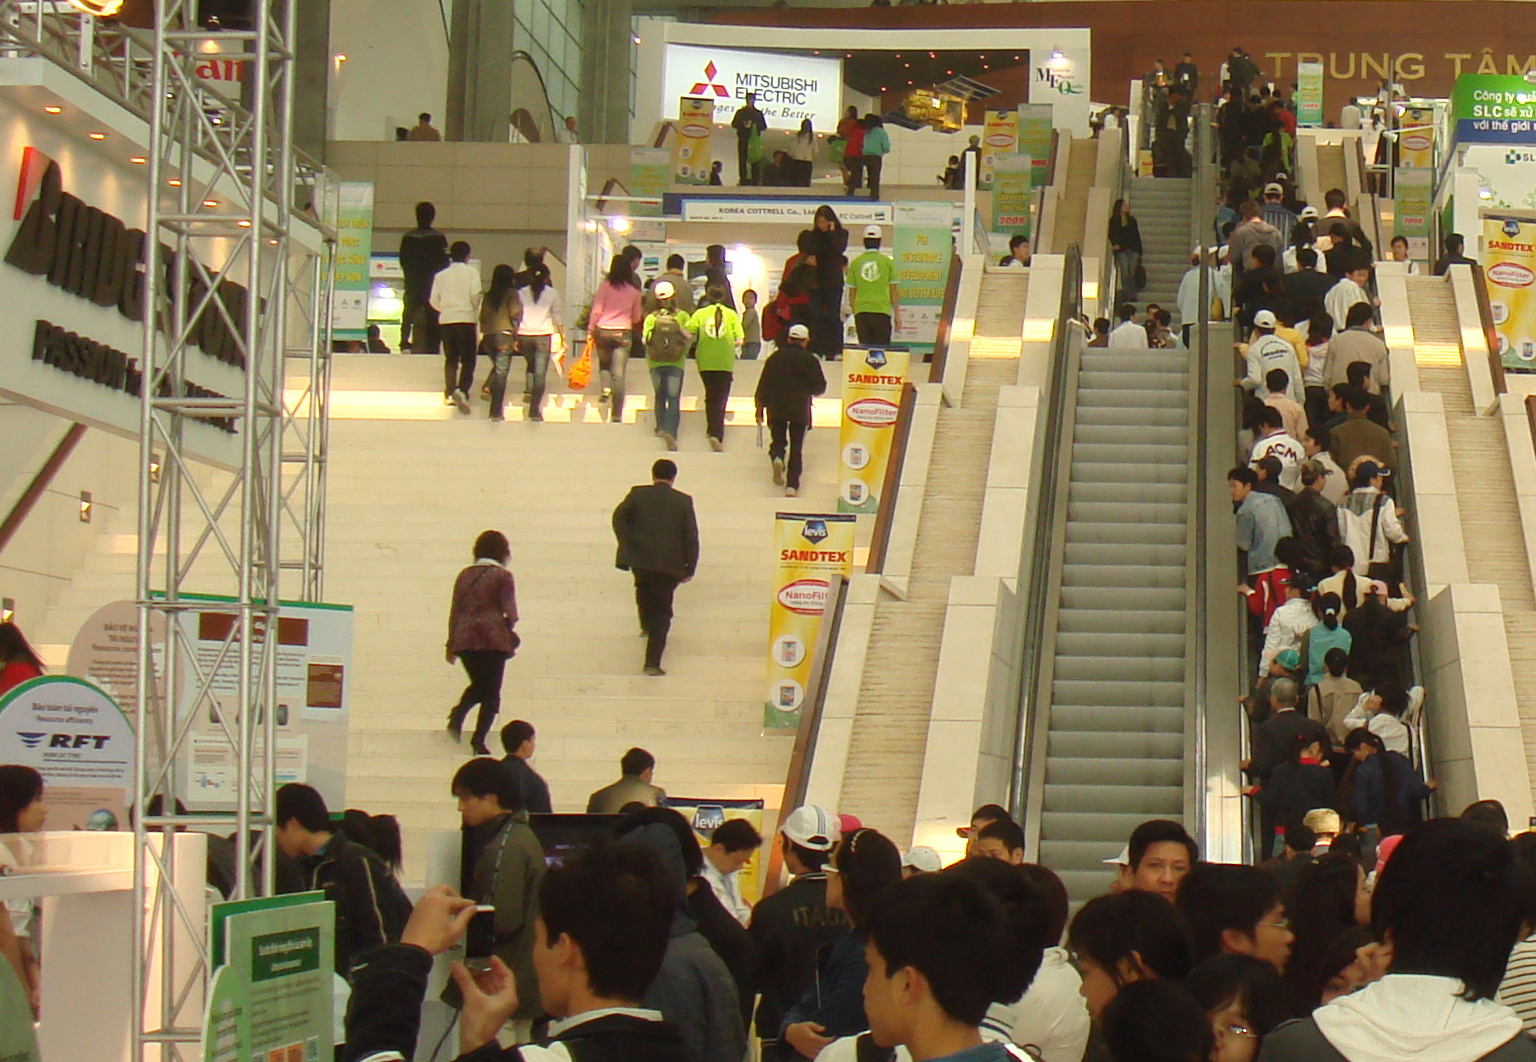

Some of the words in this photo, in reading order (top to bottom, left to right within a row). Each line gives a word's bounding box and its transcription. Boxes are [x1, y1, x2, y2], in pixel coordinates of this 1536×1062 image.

[736, 73, 817, 93] MITSUBISHI
[735, 87, 807, 105] ELECTRIC
[1473, 90, 1502, 104] Công
[1505, 91, 1515, 105] ty
[781, 107, 816, 120] Better
[1473, 104, 1503, 117] SLC
[719, 207, 745, 215] KOREA
[1488, 240, 1534, 252] SANDTEX
[848, 373, 903, 385] SANDTEX
[852, 407, 897, 416] NanoFilter
[1265, 443, 1298, 462] ACM
[803, 525, 826, 537] levis
[780, 549, 847, 563] SANDTEX
[49, 733, 111, 749] RFT
